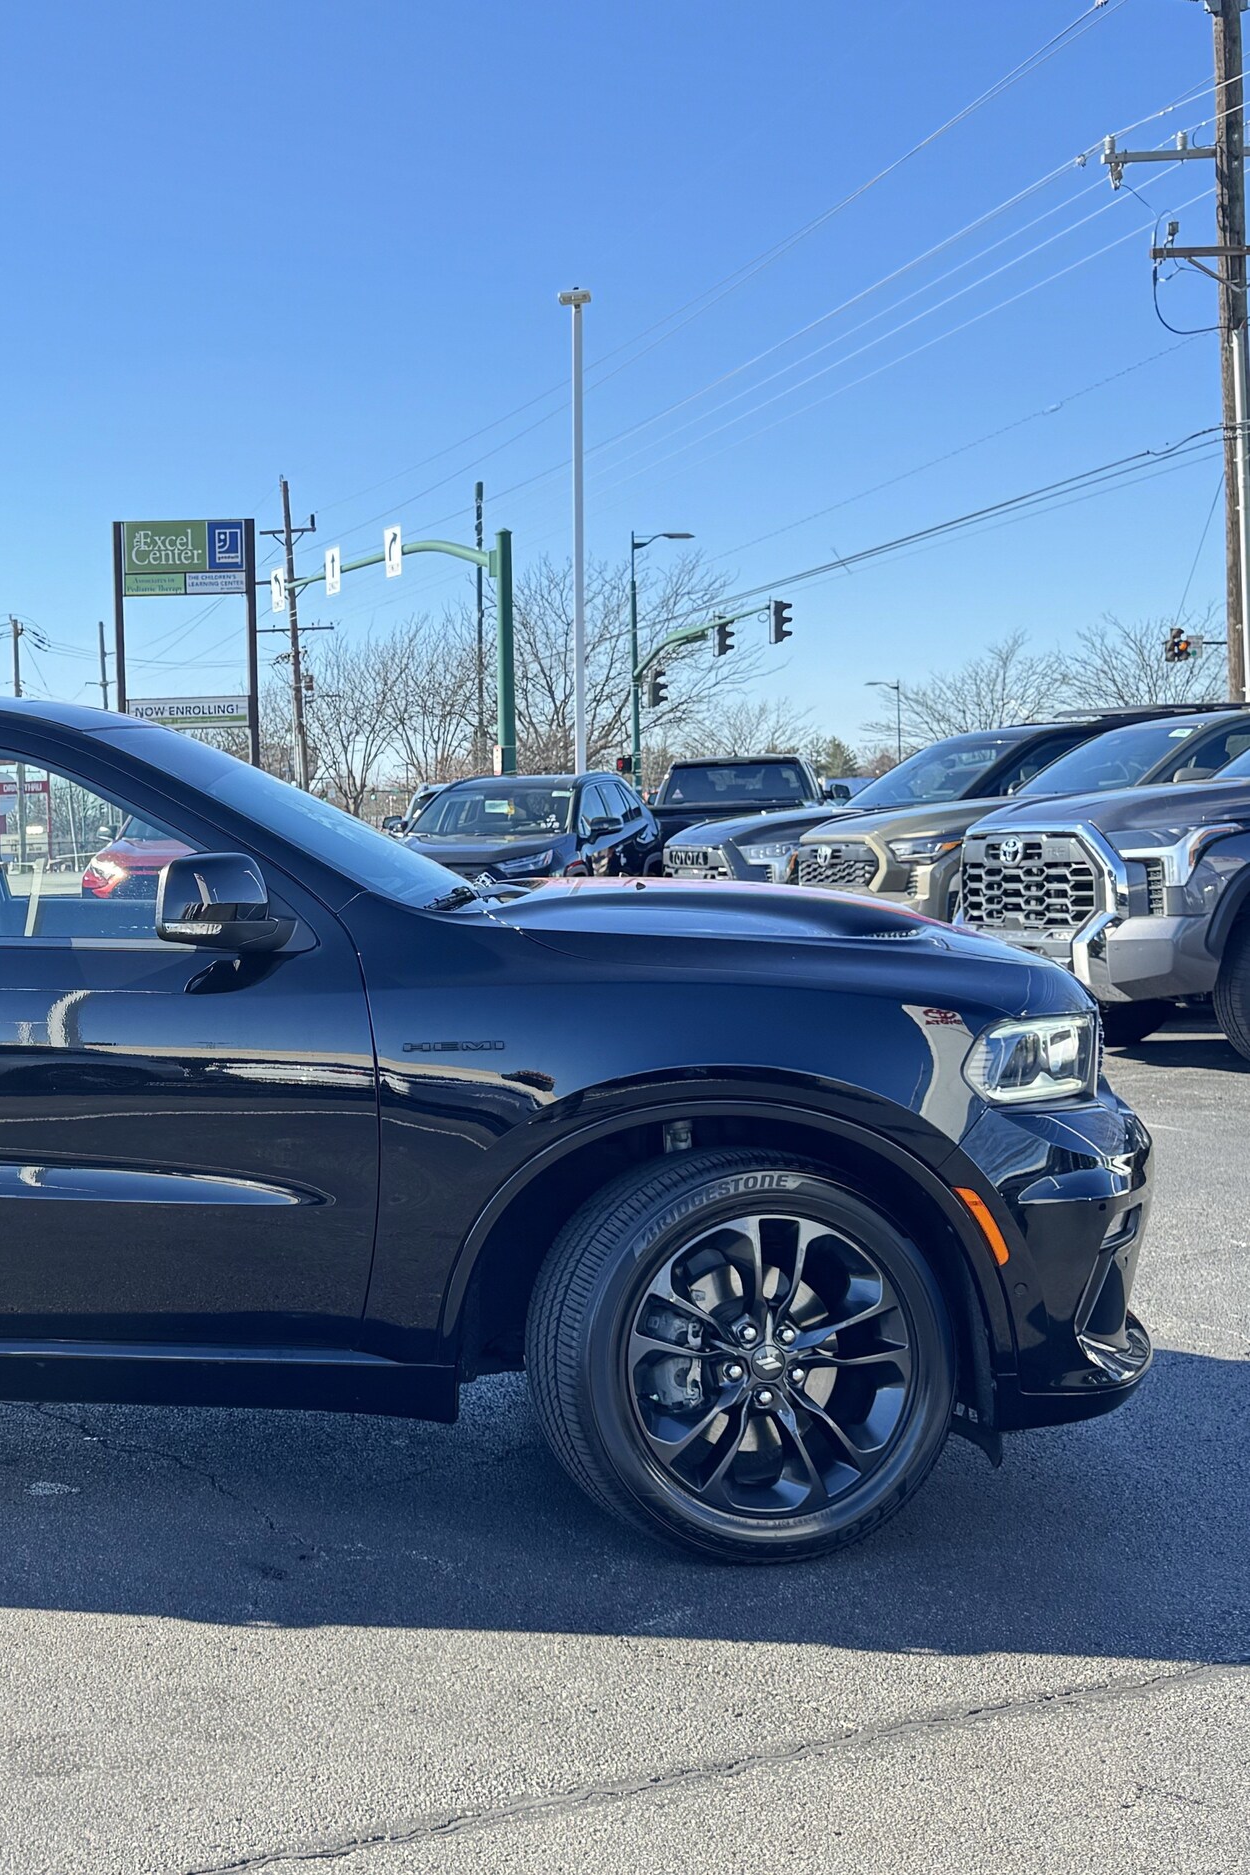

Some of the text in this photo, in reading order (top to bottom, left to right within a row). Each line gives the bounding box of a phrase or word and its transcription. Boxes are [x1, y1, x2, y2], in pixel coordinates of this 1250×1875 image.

[138, 529, 194, 551] Excel
[132, 545, 203, 565] Center
[134, 704, 239, 718] NOW ENROLLING!
[671, 851, 705, 866] TOYOTA
[402, 1040, 505, 1053] HEMI
[642, 1174, 790, 1243] BRIDGESTONE
